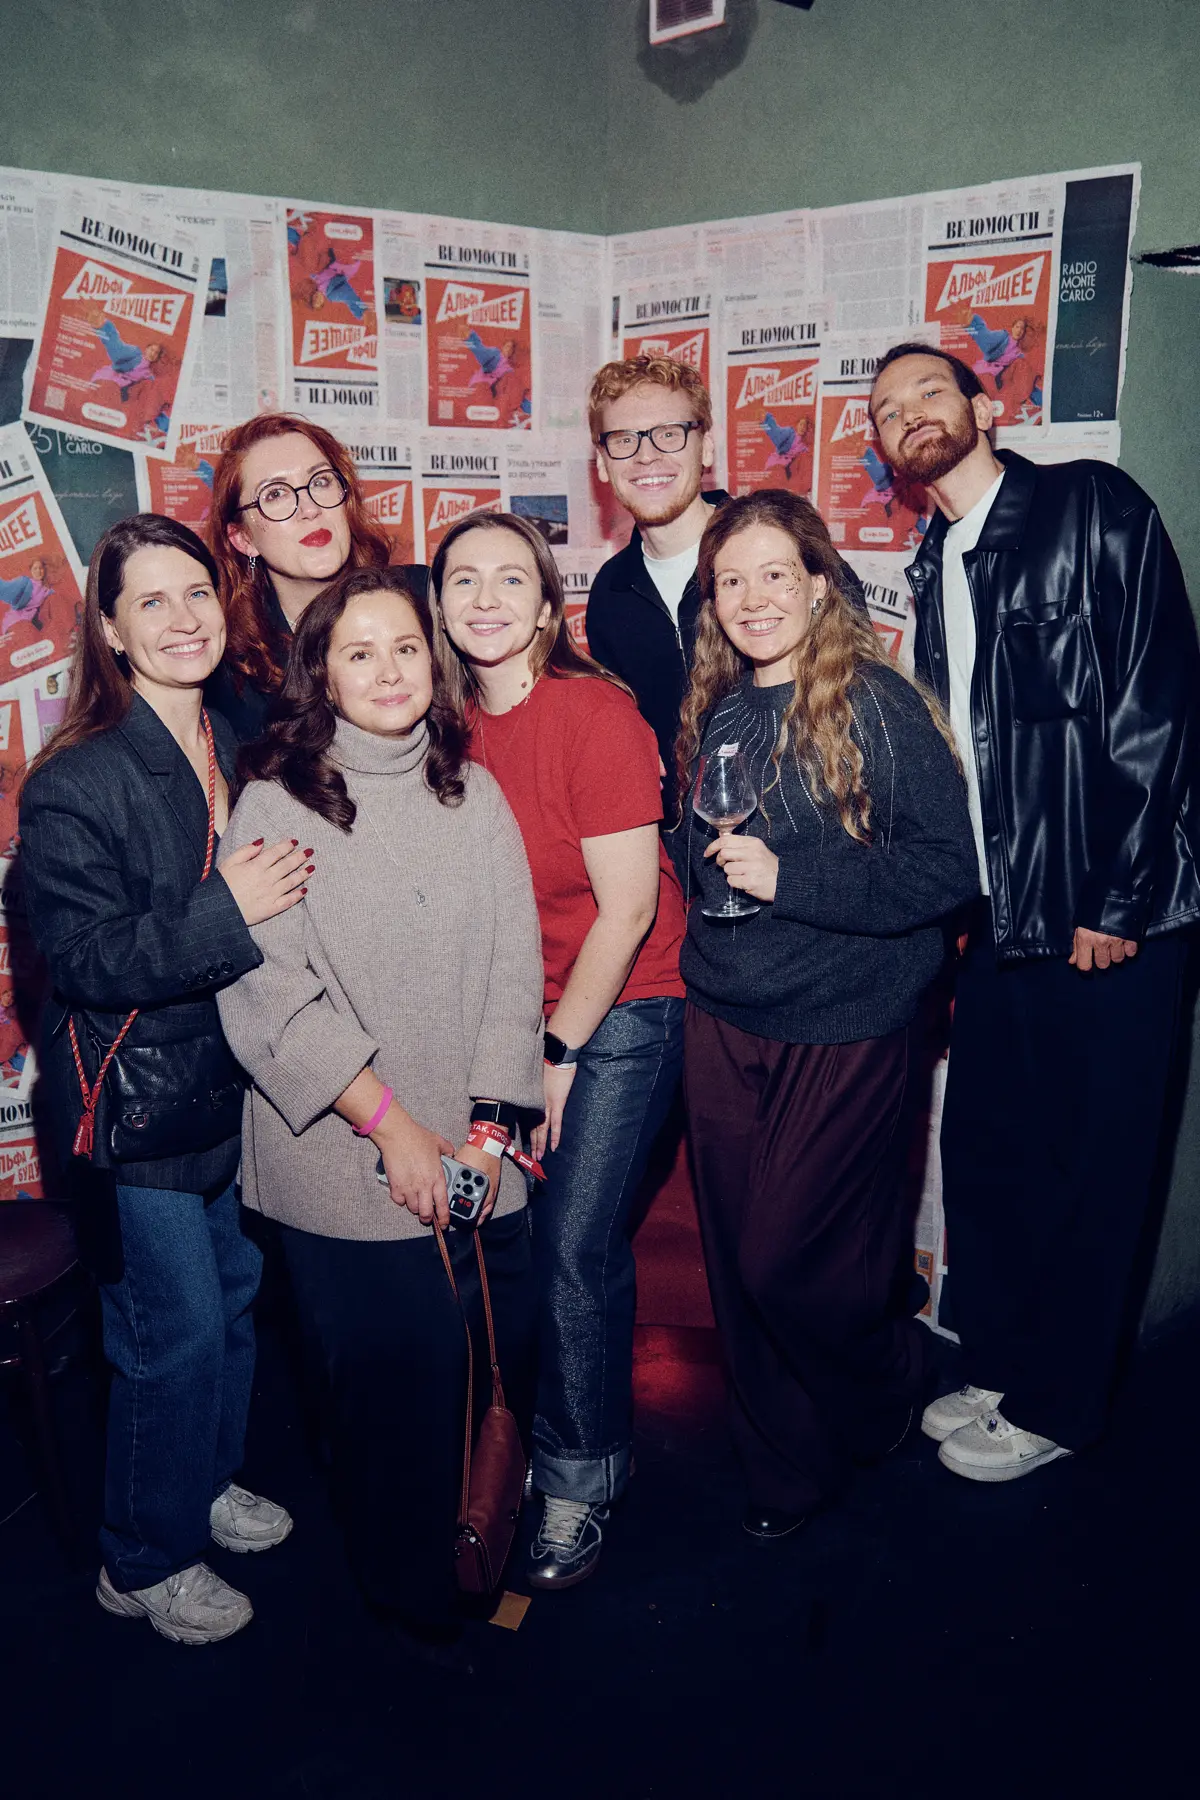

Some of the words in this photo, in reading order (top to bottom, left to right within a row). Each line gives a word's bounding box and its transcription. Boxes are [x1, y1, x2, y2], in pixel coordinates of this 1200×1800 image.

[946, 211, 1040, 239] ВЕДОМОСТИ
[81, 216, 183, 268] ВЕДОМОСТИ
[1062, 261, 1098, 275] RADIO
[76, 271, 124, 296] АЛЬФА
[947, 270, 987, 301] АЛЬФА
[975, 266, 1035, 304] БУДУЩЕЕ
[1061, 274, 1096, 289] MONTE
[1060, 288, 1096, 302] CARLO
[110, 297, 175, 325] БУДУЩЕЕ
[65, 442, 103, 455] CARLO
